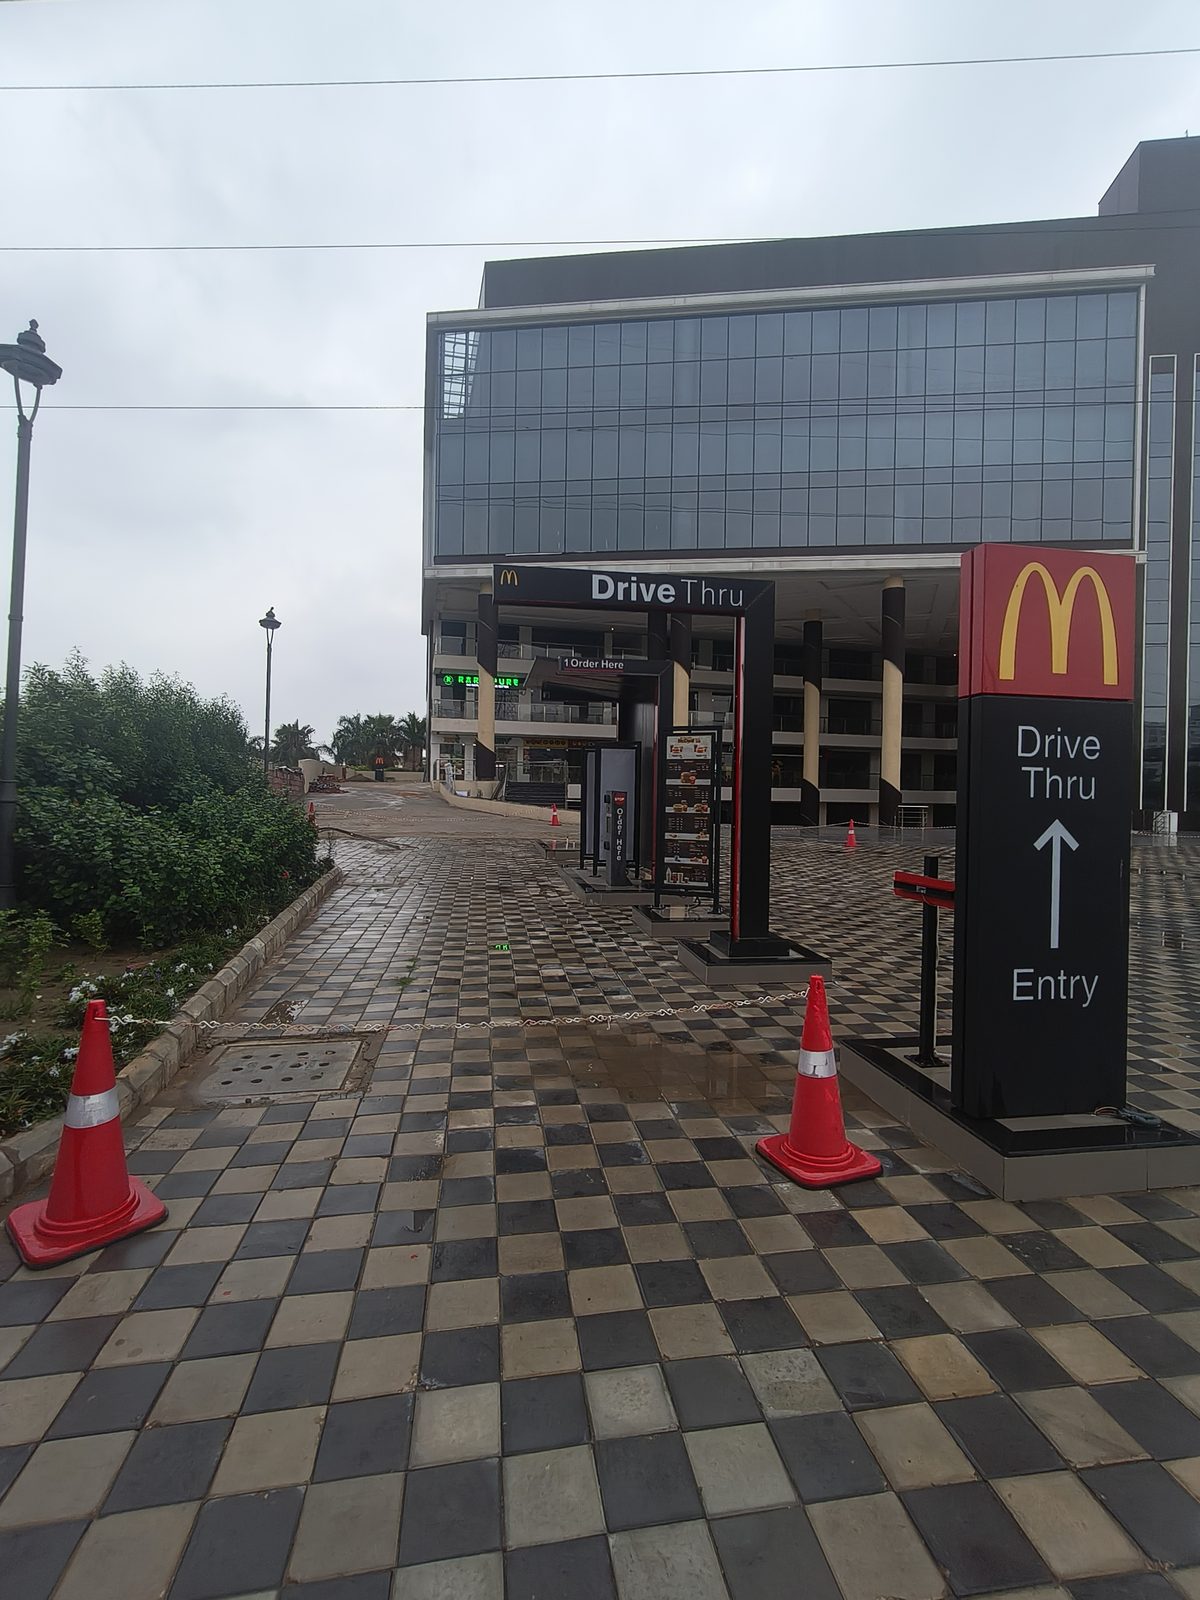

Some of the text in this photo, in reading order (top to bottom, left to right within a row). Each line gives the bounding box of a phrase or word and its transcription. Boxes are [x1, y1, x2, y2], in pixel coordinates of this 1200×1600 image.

[592, 574, 676, 603] Drive
[681, 579, 743, 606] Thru
[571, 658, 599, 668] Order
[601, 659, 624, 669] Here
[458, 676, 479, 684] RAR
[1017, 725, 1101, 760] Drive
[1021, 766, 1096, 800] Thru
[616, 808, 624, 835] Order
[1012, 968, 1099, 1008] Entry
